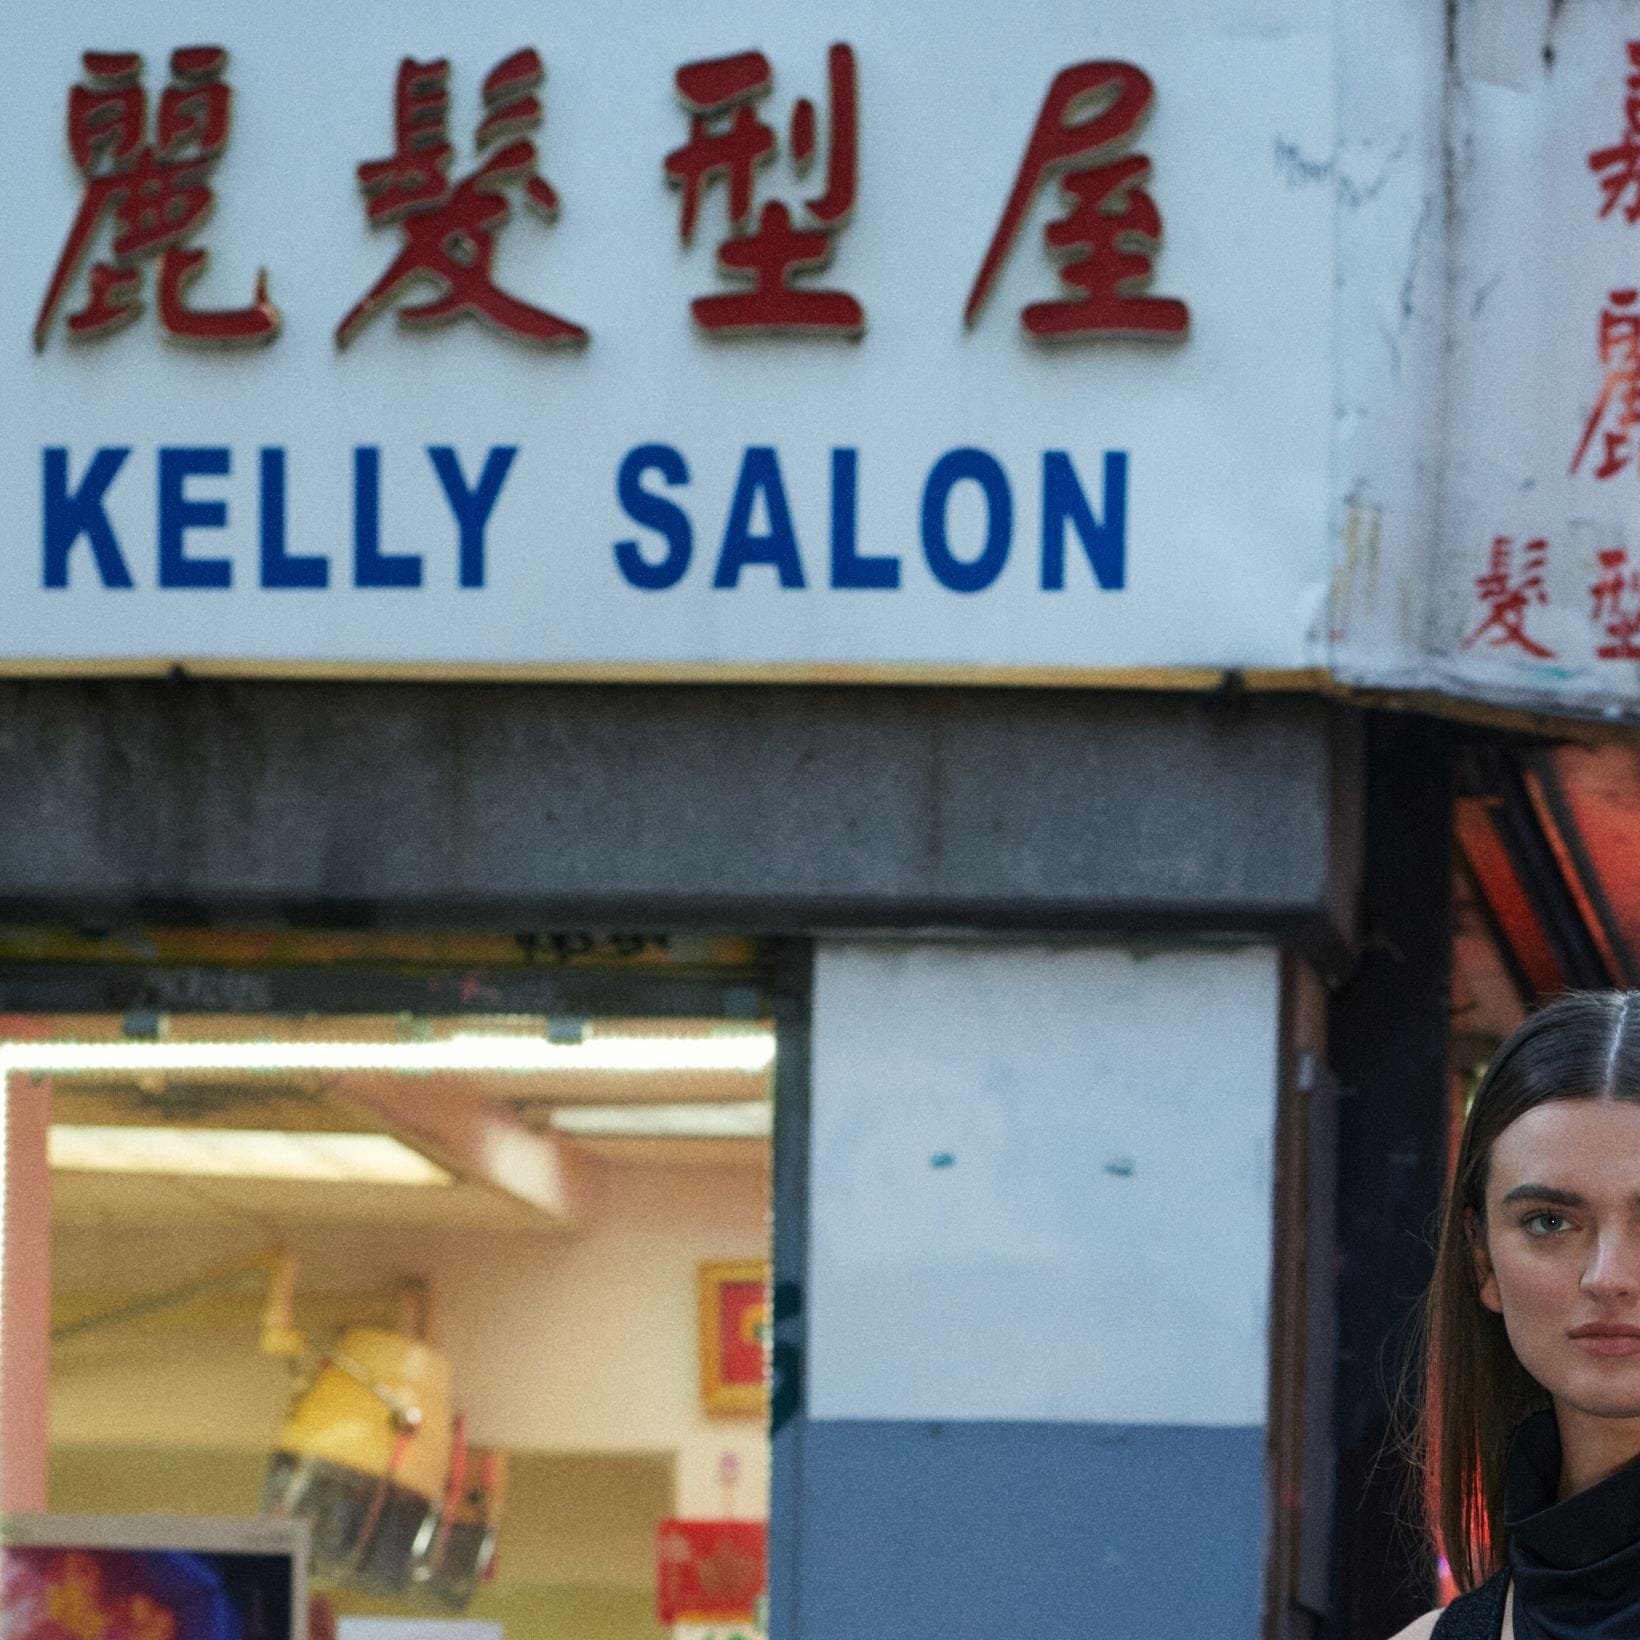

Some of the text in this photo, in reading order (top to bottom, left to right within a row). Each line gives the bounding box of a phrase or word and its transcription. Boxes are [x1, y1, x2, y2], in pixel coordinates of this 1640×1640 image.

[33, 41, 1193, 351] 麗髮型屋
[40, 442, 1129, 593] KELLY SALON
